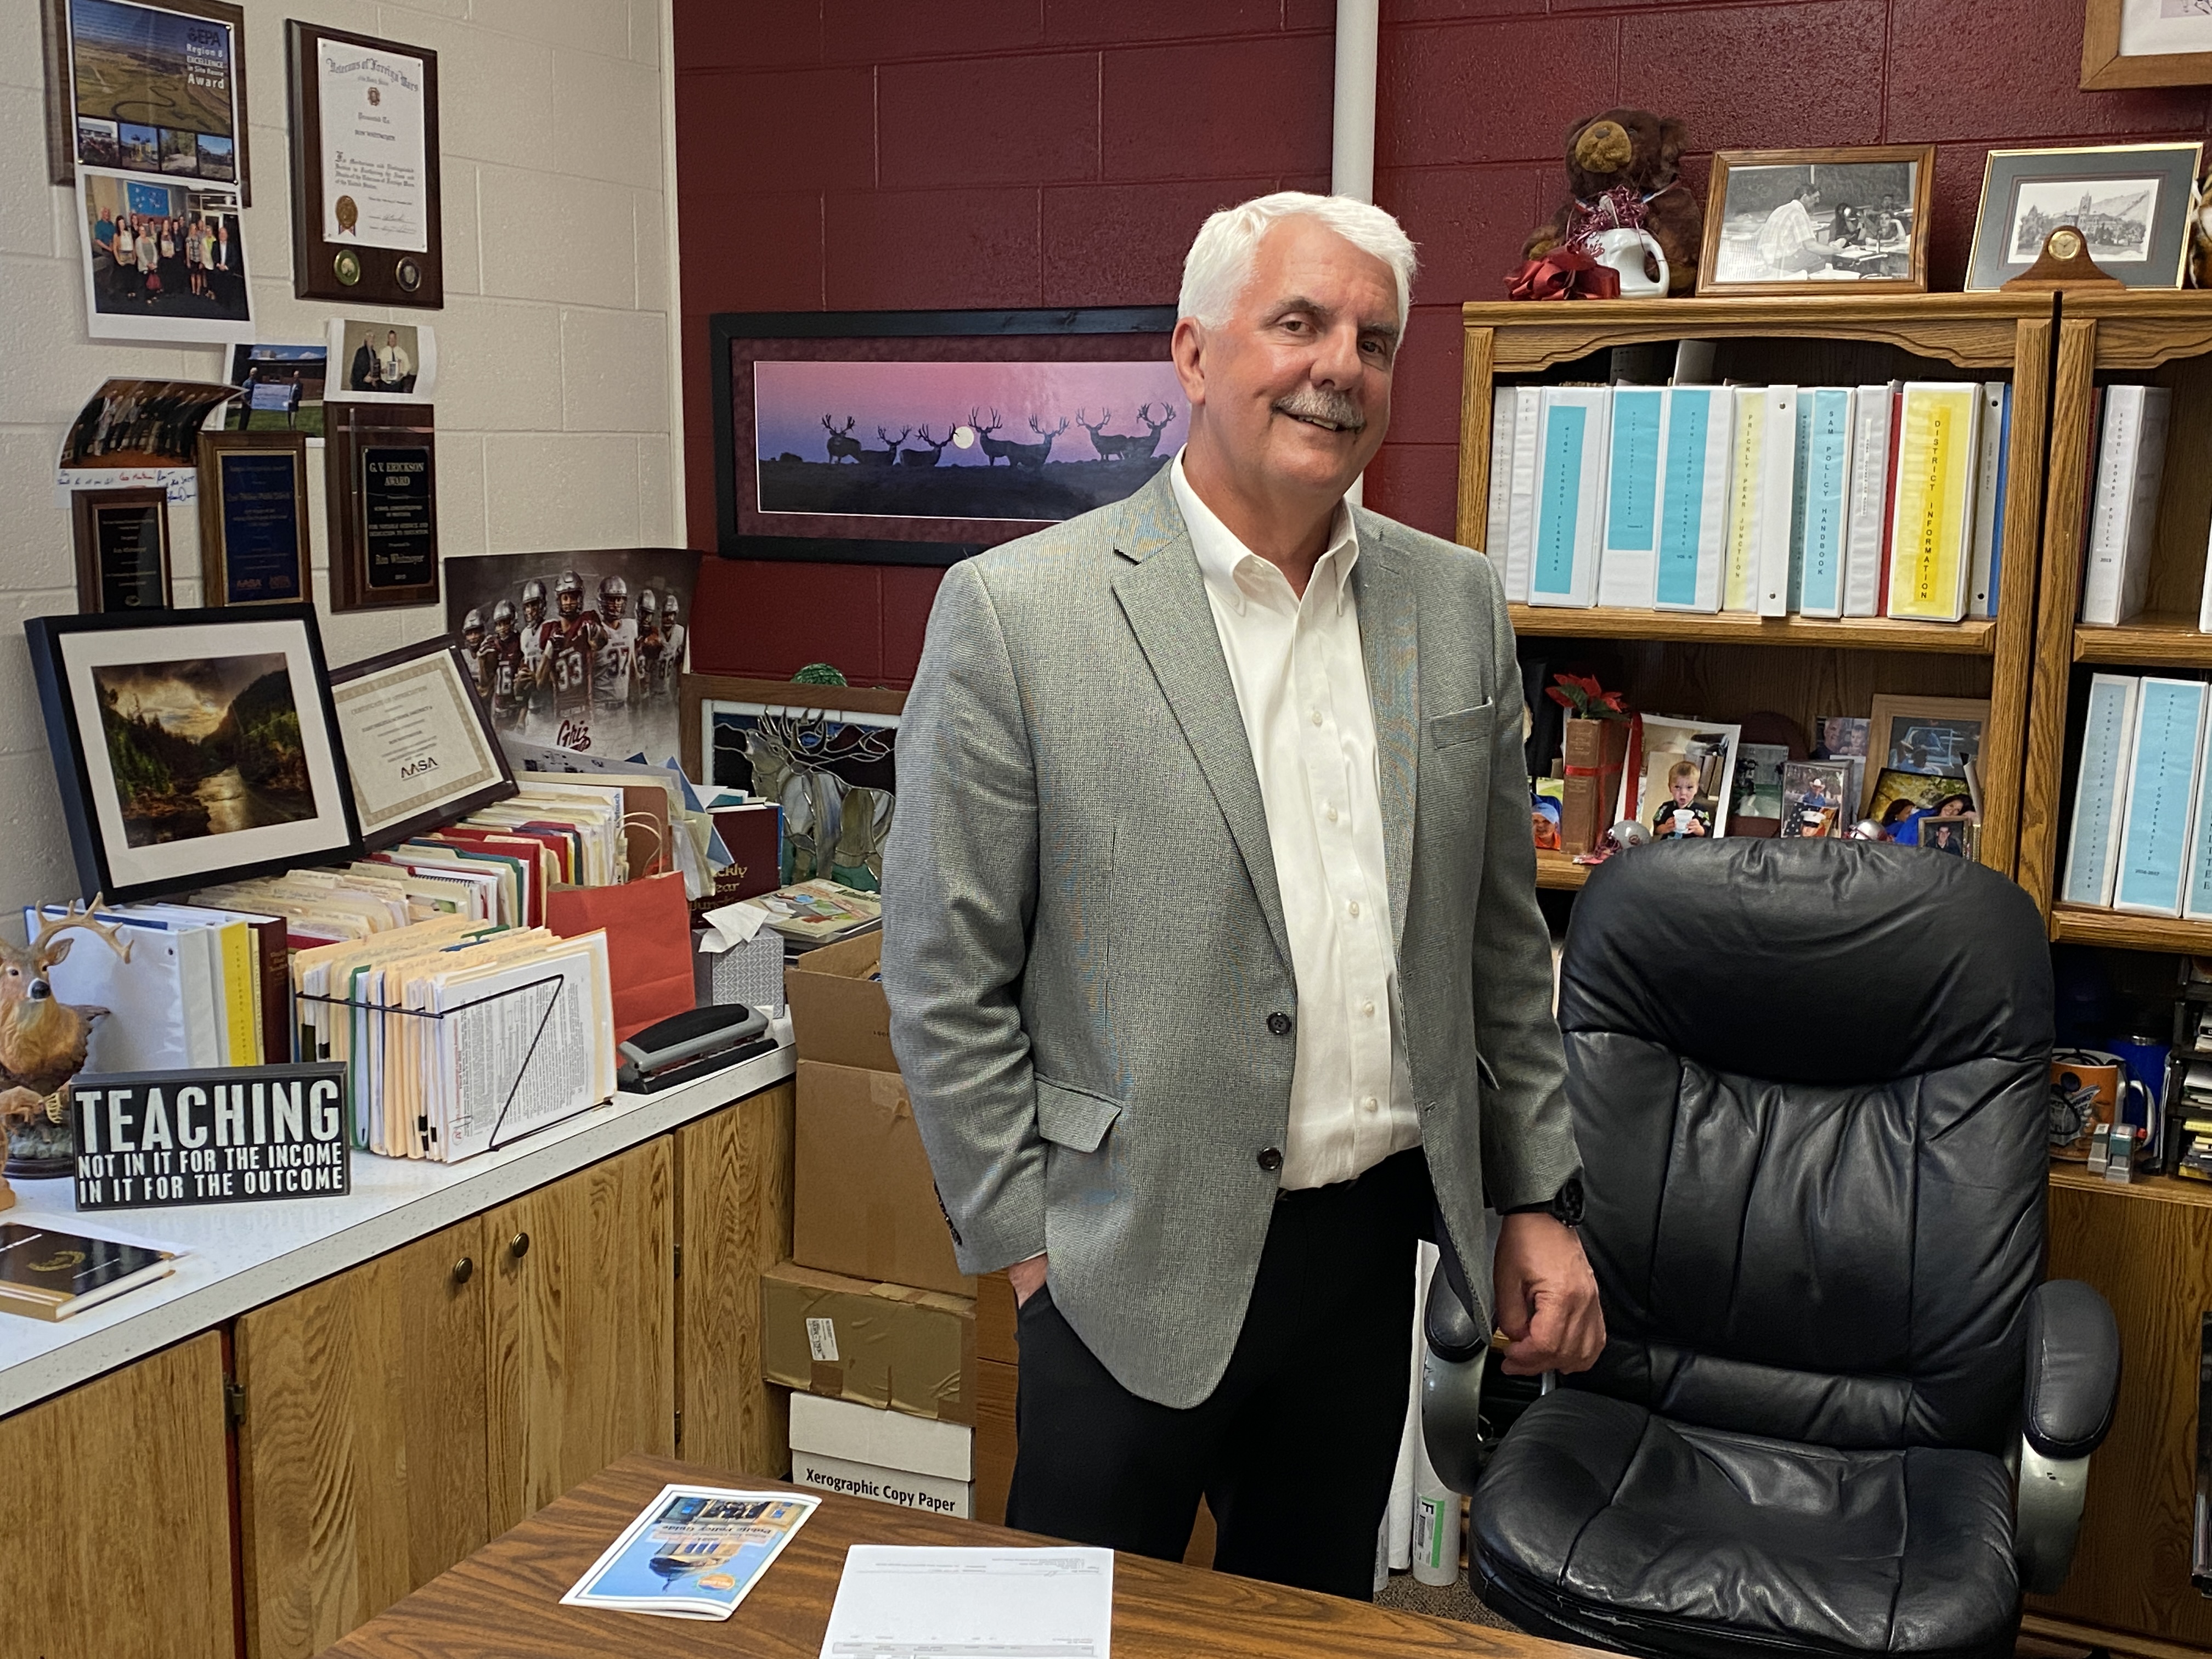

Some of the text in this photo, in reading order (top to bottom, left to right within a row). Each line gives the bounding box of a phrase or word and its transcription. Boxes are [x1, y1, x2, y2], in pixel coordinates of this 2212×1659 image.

[187, 43, 216, 57] Region
[197, 29, 221, 46] EPA
[187, 55, 223, 68] EXCELLENCE
[326, 58, 360, 73] Veterans
[367, 58, 398, 82] Foreign
[399, 71, 418, 91] Wars
[188, 74, 224, 89] Award
[1745, 414, 1753, 469] PRICKLY
[1823, 446, 1832, 497] POLICY
[1681, 493, 1689, 546] PLANNING
[1921, 420, 1940, 599] DISTRICT INFORMATION
[1553, 515, 1562, 572] PLANNING
[1735, 518, 1743, 578] JUNCTION
[1818, 508, 1827, 575] HANDBOOK
[496, 666, 511, 694] 16
[556, 651, 583, 692] 33
[607, 647, 629, 678] 37
[557, 720, 591, 748] Griz
[2164, 693, 2175, 742] PRICKLY
[400, 757, 438, 779] AASA
[2147, 786, 2162, 861] COOPERATIVE
[715, 882, 740, 893] ear
[75, 1080, 339, 1153] TEACHING
[78, 1142, 342, 1178] NOT IN IT FOR THE INCOME
[80, 1166, 343, 1204] IN IT FOR THE OUTCOME
[806, 1468, 956, 1513] Xerographic Copy Paper
[1421, 1501, 1434, 1516] F
